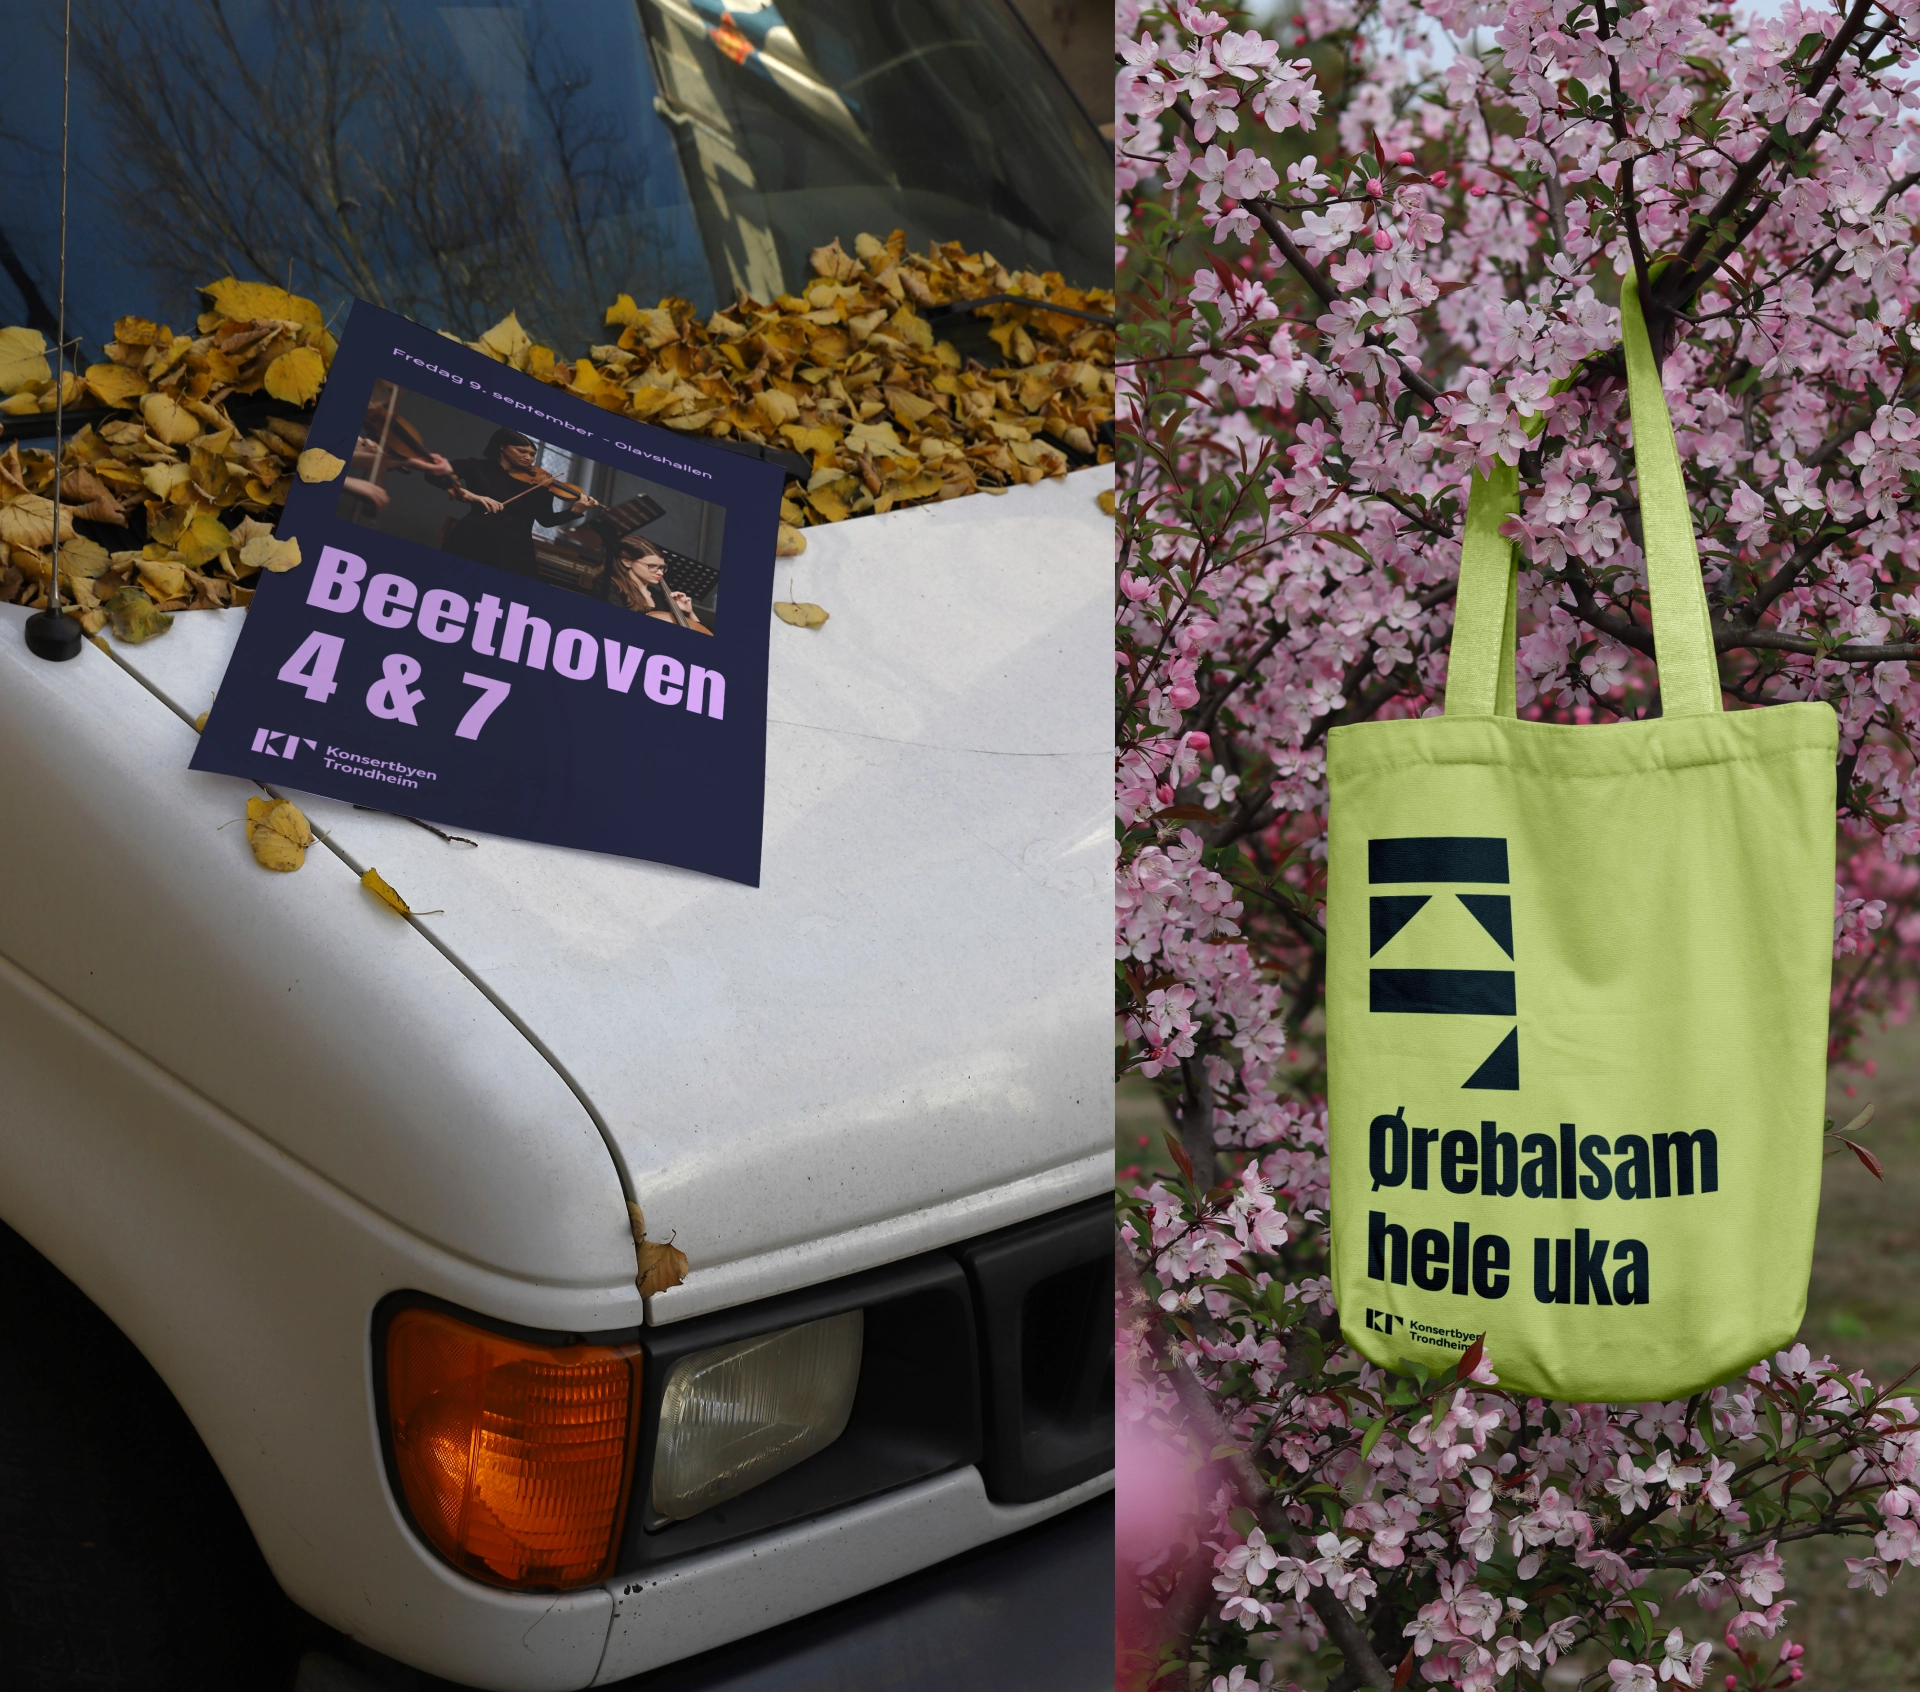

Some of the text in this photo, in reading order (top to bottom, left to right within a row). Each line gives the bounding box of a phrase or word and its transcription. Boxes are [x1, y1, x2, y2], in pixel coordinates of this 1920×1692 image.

[392, 347, 464, 385] Fredag
[469, 380, 487, 394] 9.
[492, 391, 595, 438] september
[614, 441, 713, 480] Olavshallen
[305, 544, 726, 721] Beethoven
[276, 630, 512, 741] 4 & 7
[323, 757, 418, 789] Trondheim
[326, 745, 437, 781] Konsertbyen
[1368, 1105, 1719, 1201] Ørebalsam
[1367, 1210, 1650, 1306] hele uka
